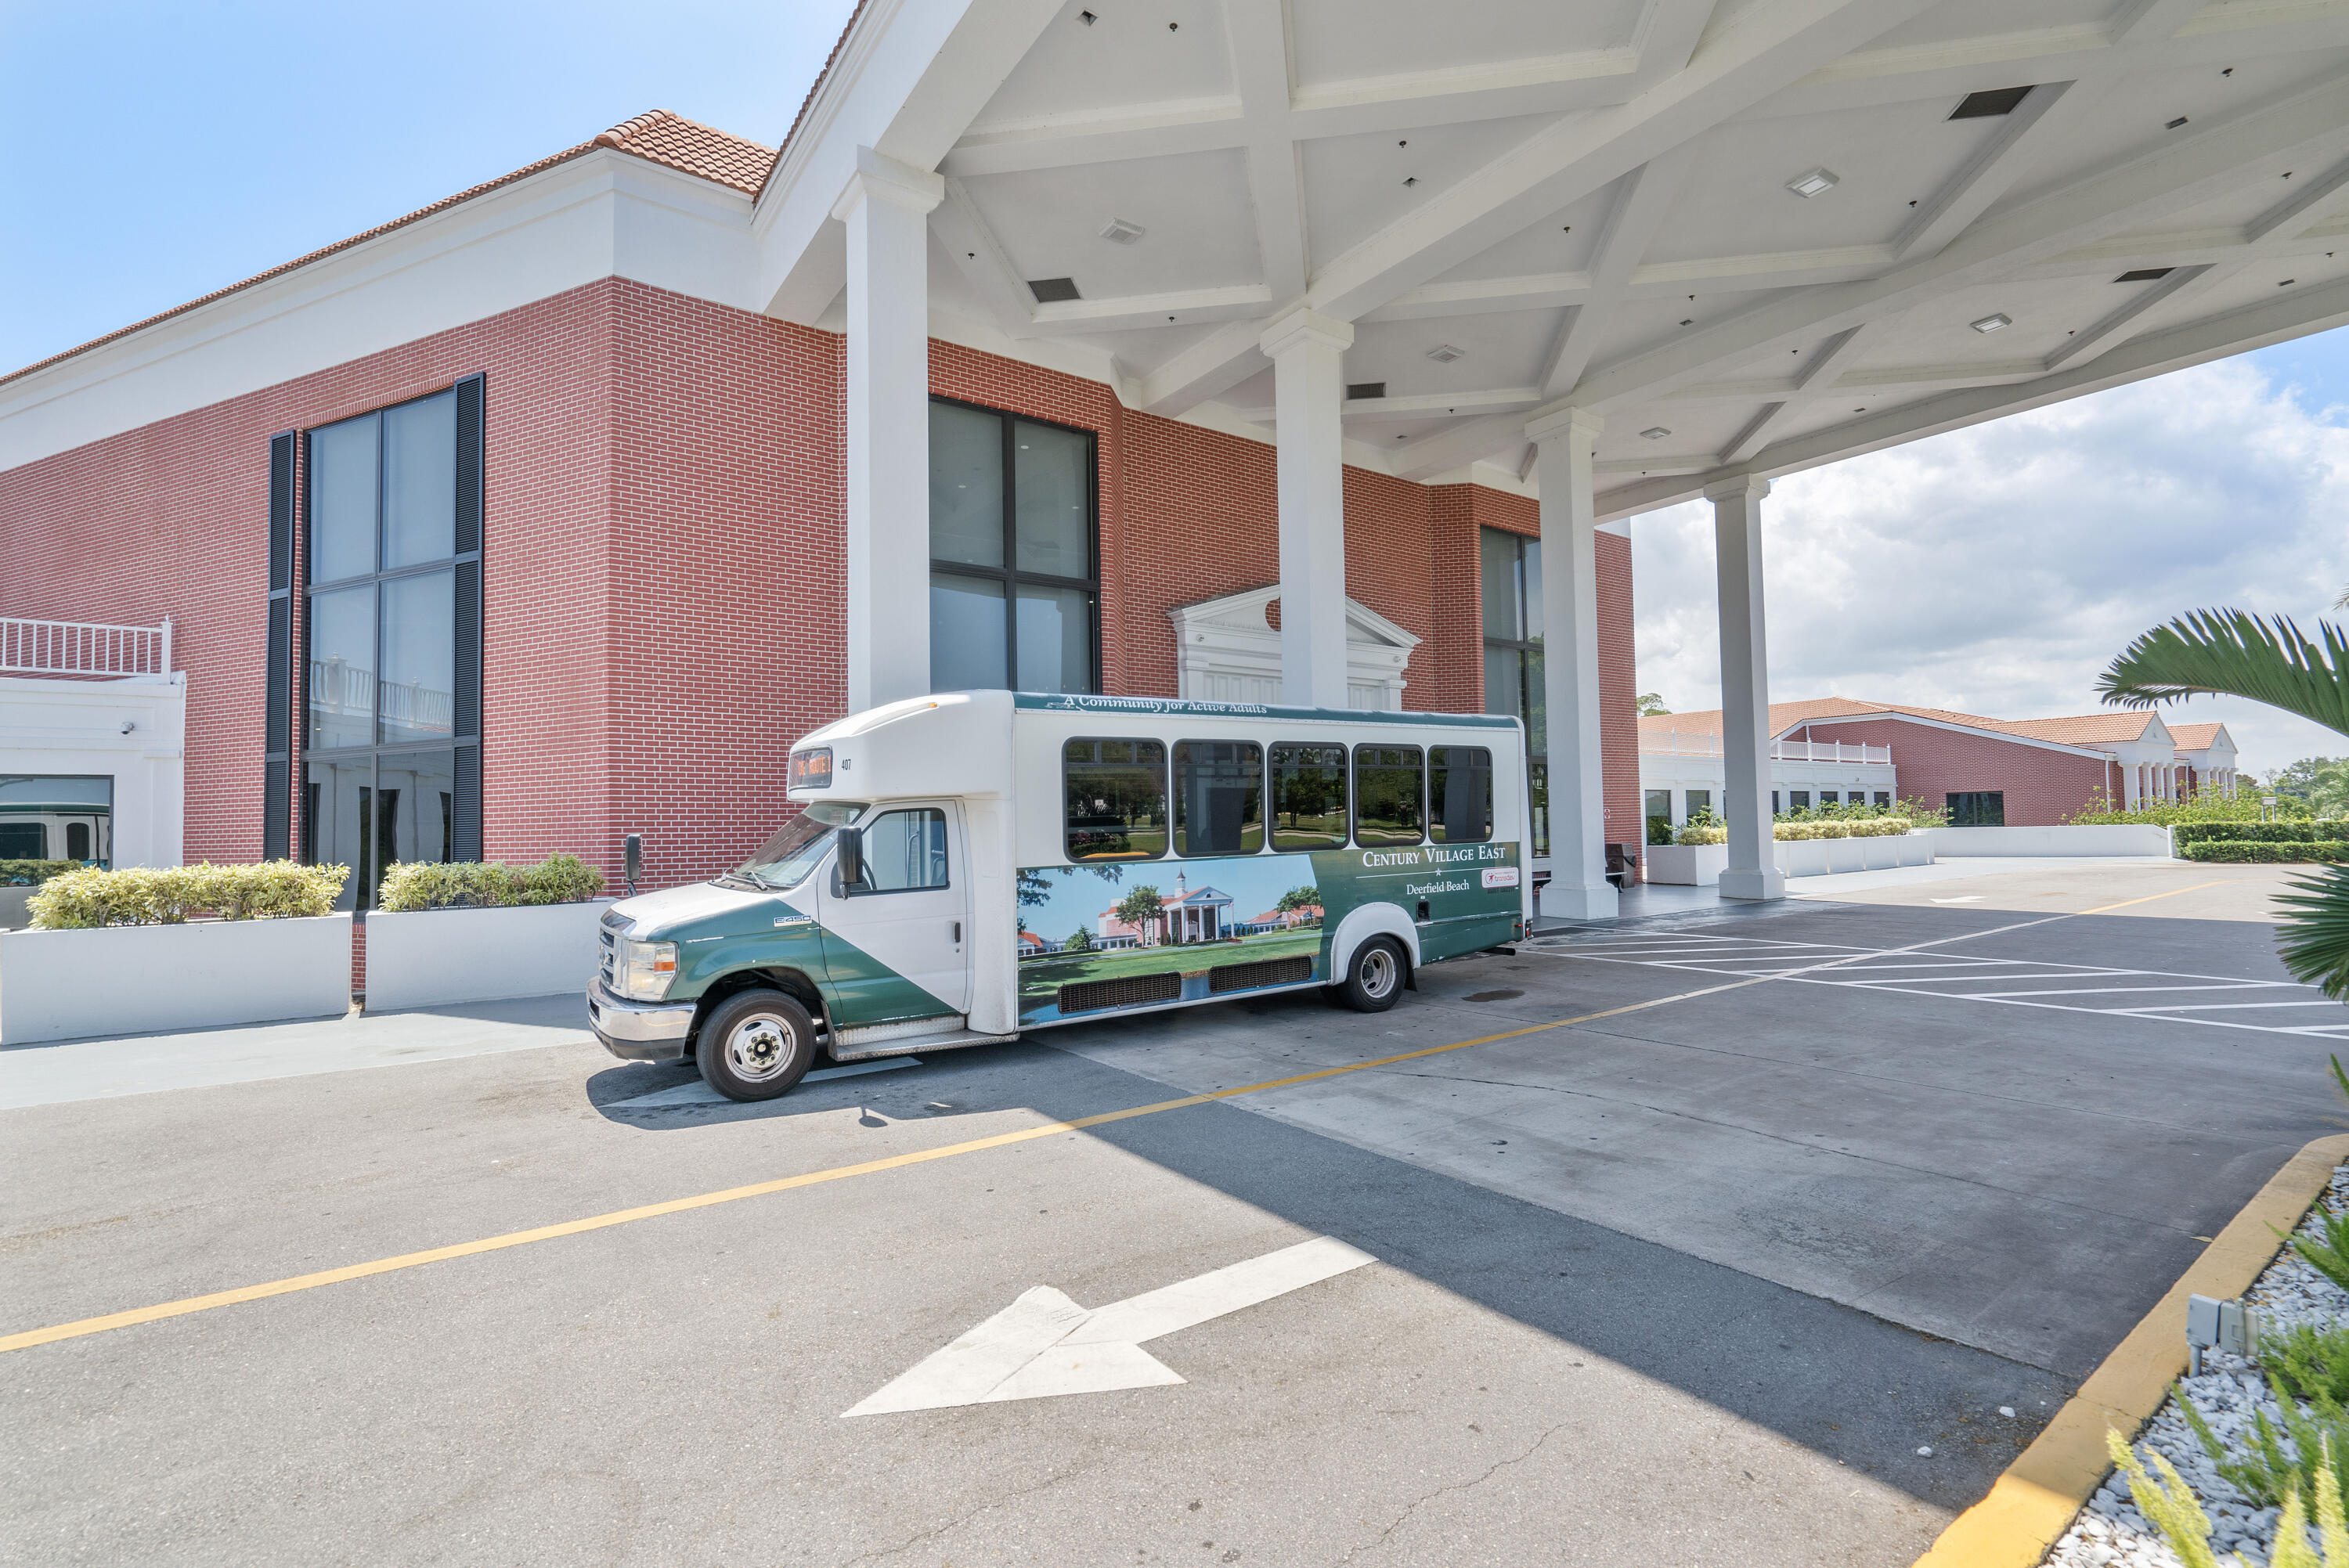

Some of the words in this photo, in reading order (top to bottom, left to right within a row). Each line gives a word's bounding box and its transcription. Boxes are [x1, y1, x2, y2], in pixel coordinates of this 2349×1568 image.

[1063, 696, 1074, 706] A
[1078, 696, 1162, 712] Community
[1164, 701, 1185, 713] for
[1188, 701, 1225, 712] Active
[1229, 703, 1268, 714] Adults
[841, 759, 852, 771] 407
[1362, 851, 1420, 867] CENTURY
[1424, 848, 1474, 863] VILLAGE
[1478, 845, 1506, 860] EAST
[1406, 881, 1445, 895] Deerfield
[1446, 879, 1470, 892] Beach
[774, 915, 812, 924] E-450
